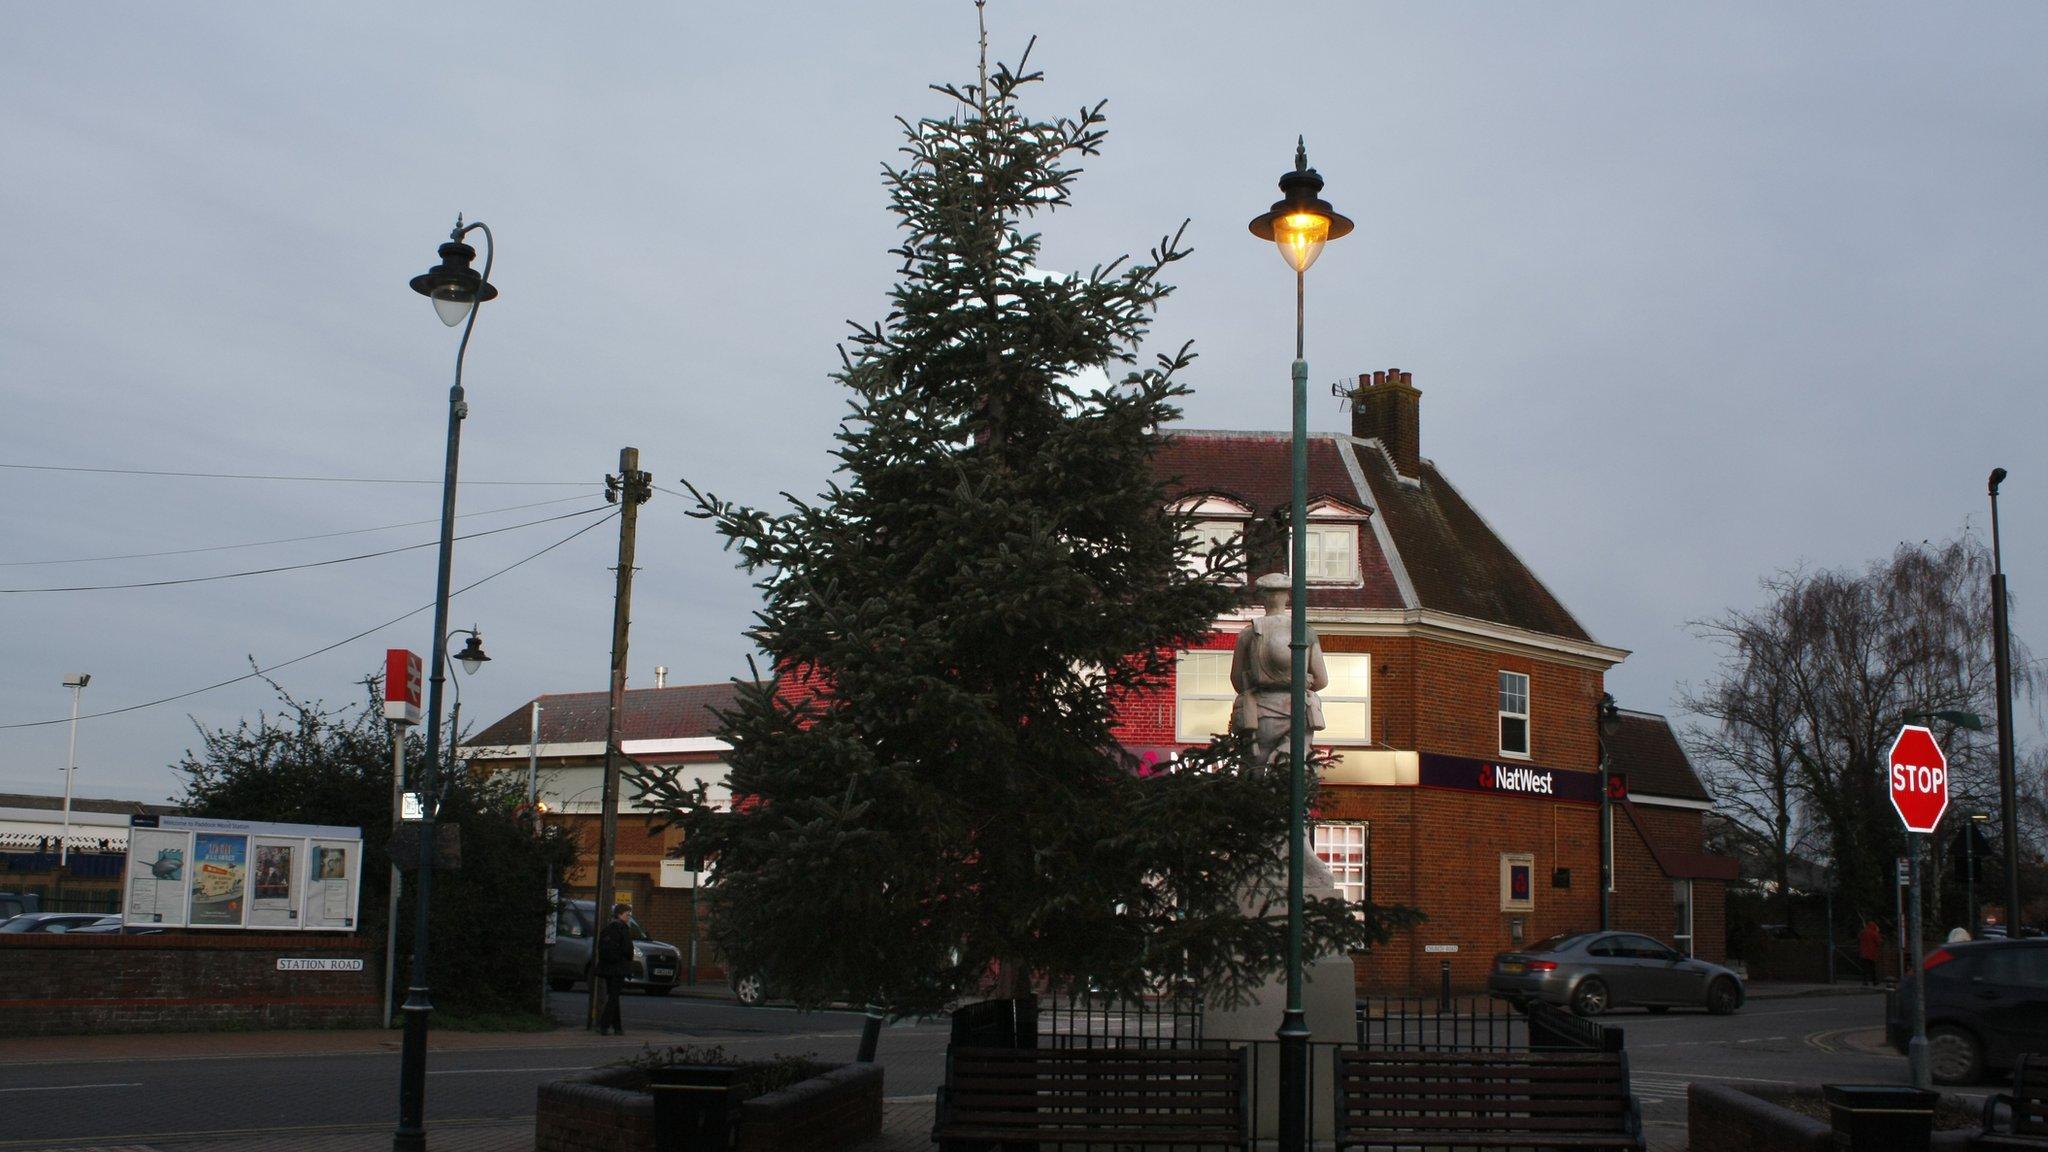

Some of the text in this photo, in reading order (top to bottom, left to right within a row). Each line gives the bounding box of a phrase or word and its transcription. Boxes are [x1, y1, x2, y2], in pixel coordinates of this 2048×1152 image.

[1495, 765, 1553, 795] NatWest
[1893, 763, 1943, 794] STOP
[280, 959, 360, 970] STATION ROAD
